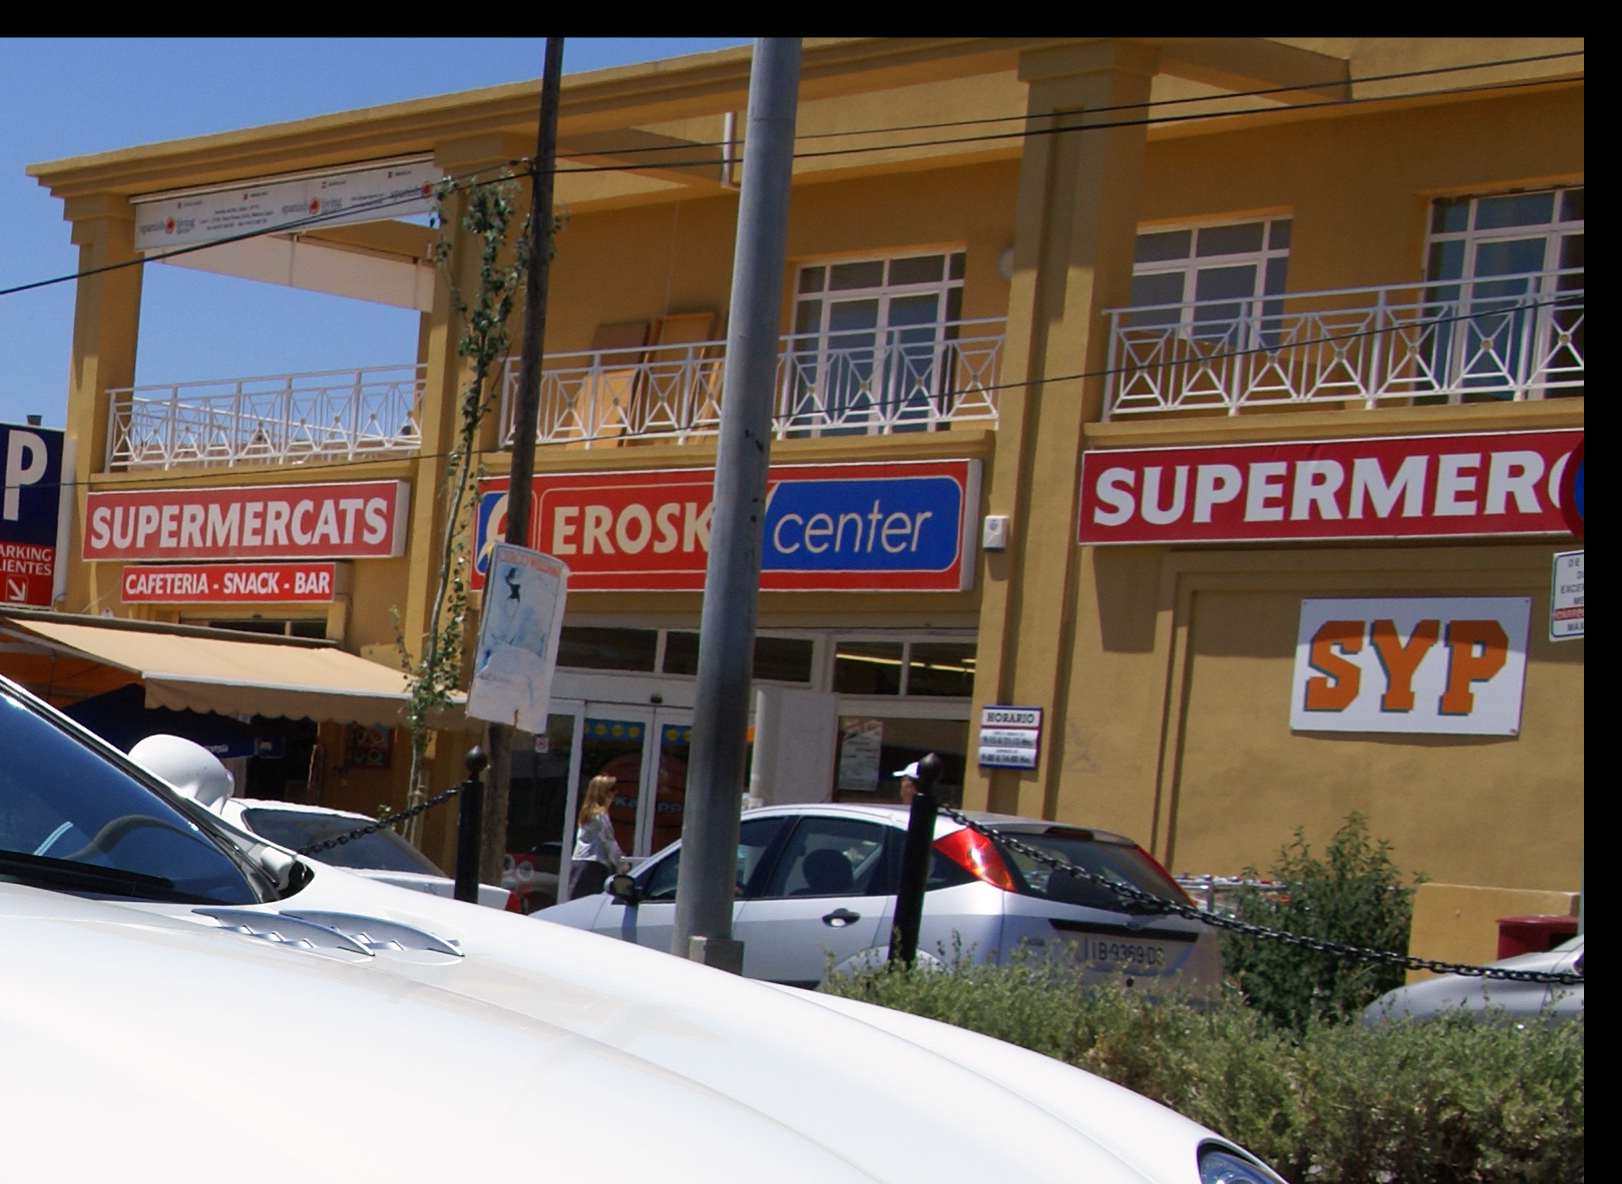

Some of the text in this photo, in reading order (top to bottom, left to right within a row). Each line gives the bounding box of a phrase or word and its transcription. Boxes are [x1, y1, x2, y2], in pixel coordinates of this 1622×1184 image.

[3, 428, 47, 522] P
[91, 497, 388, 550] SUPERMERCATS
[552, 499, 932, 556] EROSK center
[125, 572, 208, 595] CAFETERIA
[223, 571, 280, 594] SNACK
[294, 571, 330, 594] BAR
[1304, 619, 1509, 716] SYP
[987, 712, 1034, 723] HORARIO
